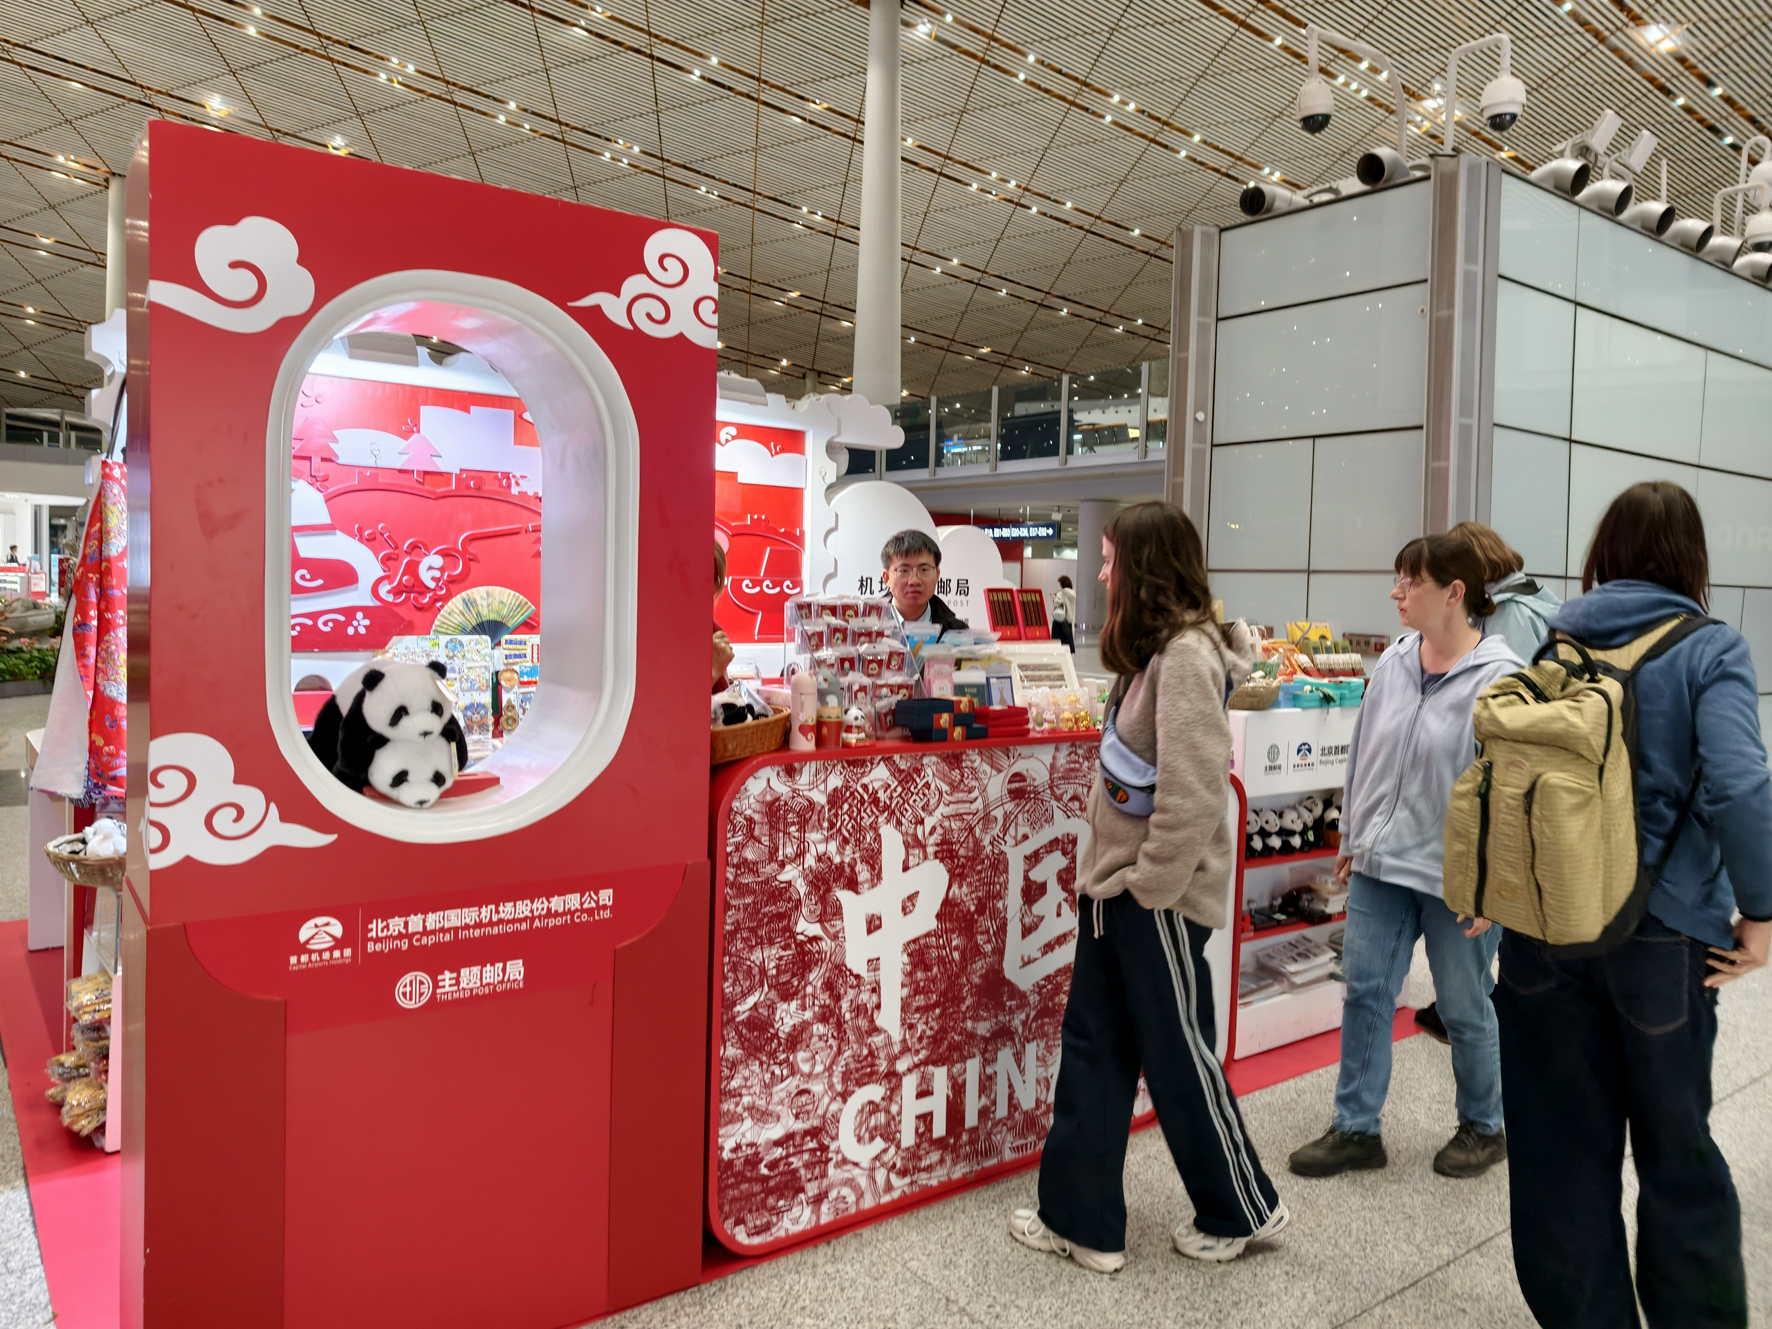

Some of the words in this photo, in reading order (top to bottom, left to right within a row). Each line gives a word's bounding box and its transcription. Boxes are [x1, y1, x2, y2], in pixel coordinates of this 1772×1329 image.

[367, 889, 614, 939] 北京首都国际机场股份有限公司
[367, 938, 408, 953] Beijing
[413, 930, 454, 947] Capital
[458, 920, 530, 939] International
[533, 914, 571, 930] Airport
[436, 959, 524, 994] 主题邮局
[437, 988, 470, 1002] THEMED
[473, 985, 494, 998] POST
[496, 981, 524, 993] OFFICE
[838, 1041, 1058, 1163] CHIN
